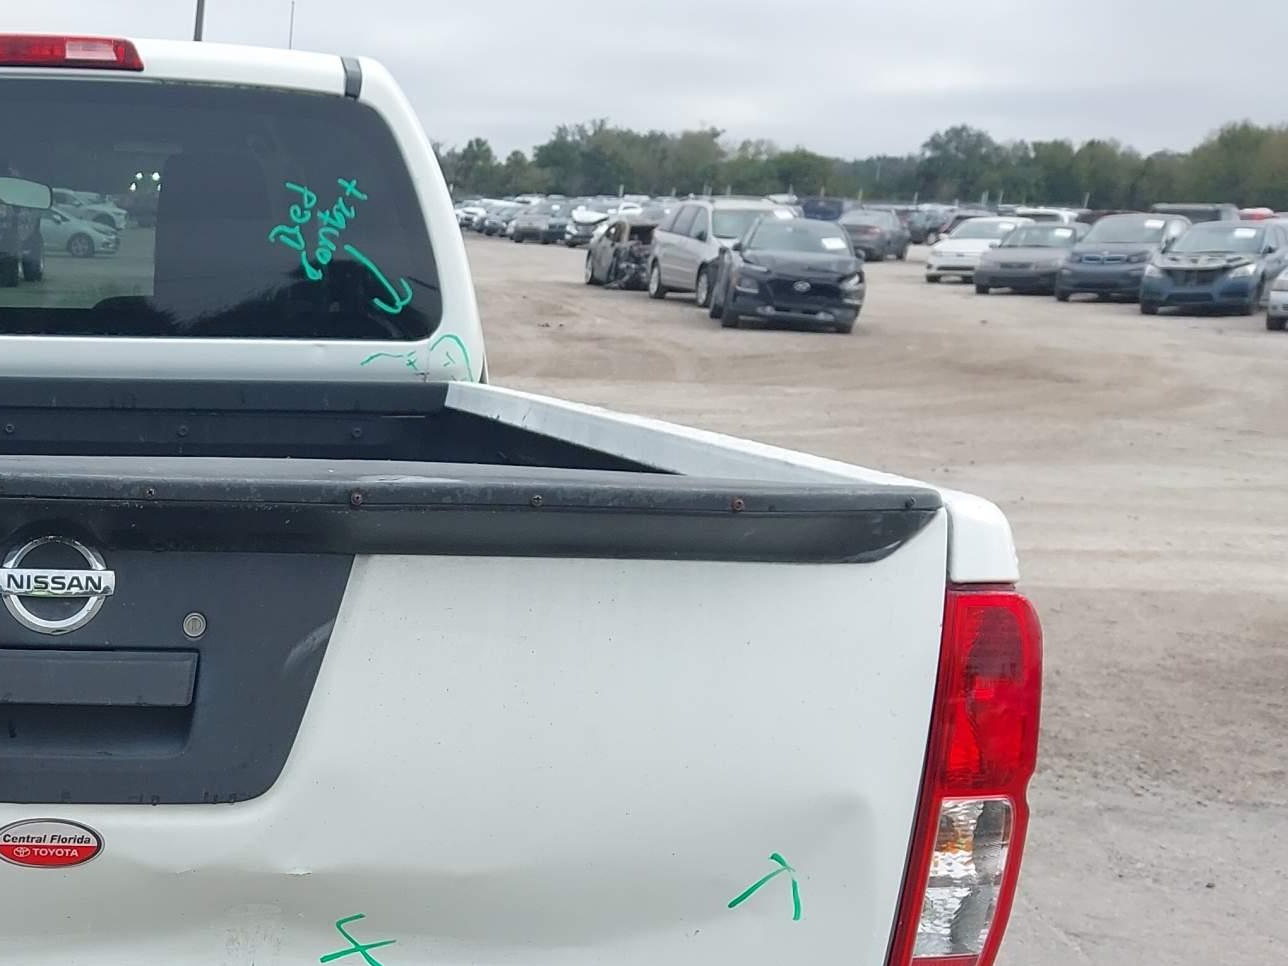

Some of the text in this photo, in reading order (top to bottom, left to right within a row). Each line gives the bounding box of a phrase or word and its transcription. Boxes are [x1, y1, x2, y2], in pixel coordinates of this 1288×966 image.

[6, 573, 103, 592] NISSAN
[3, 833, 91, 845] Central Florida
[32, 847, 79, 857] TOYOTA
